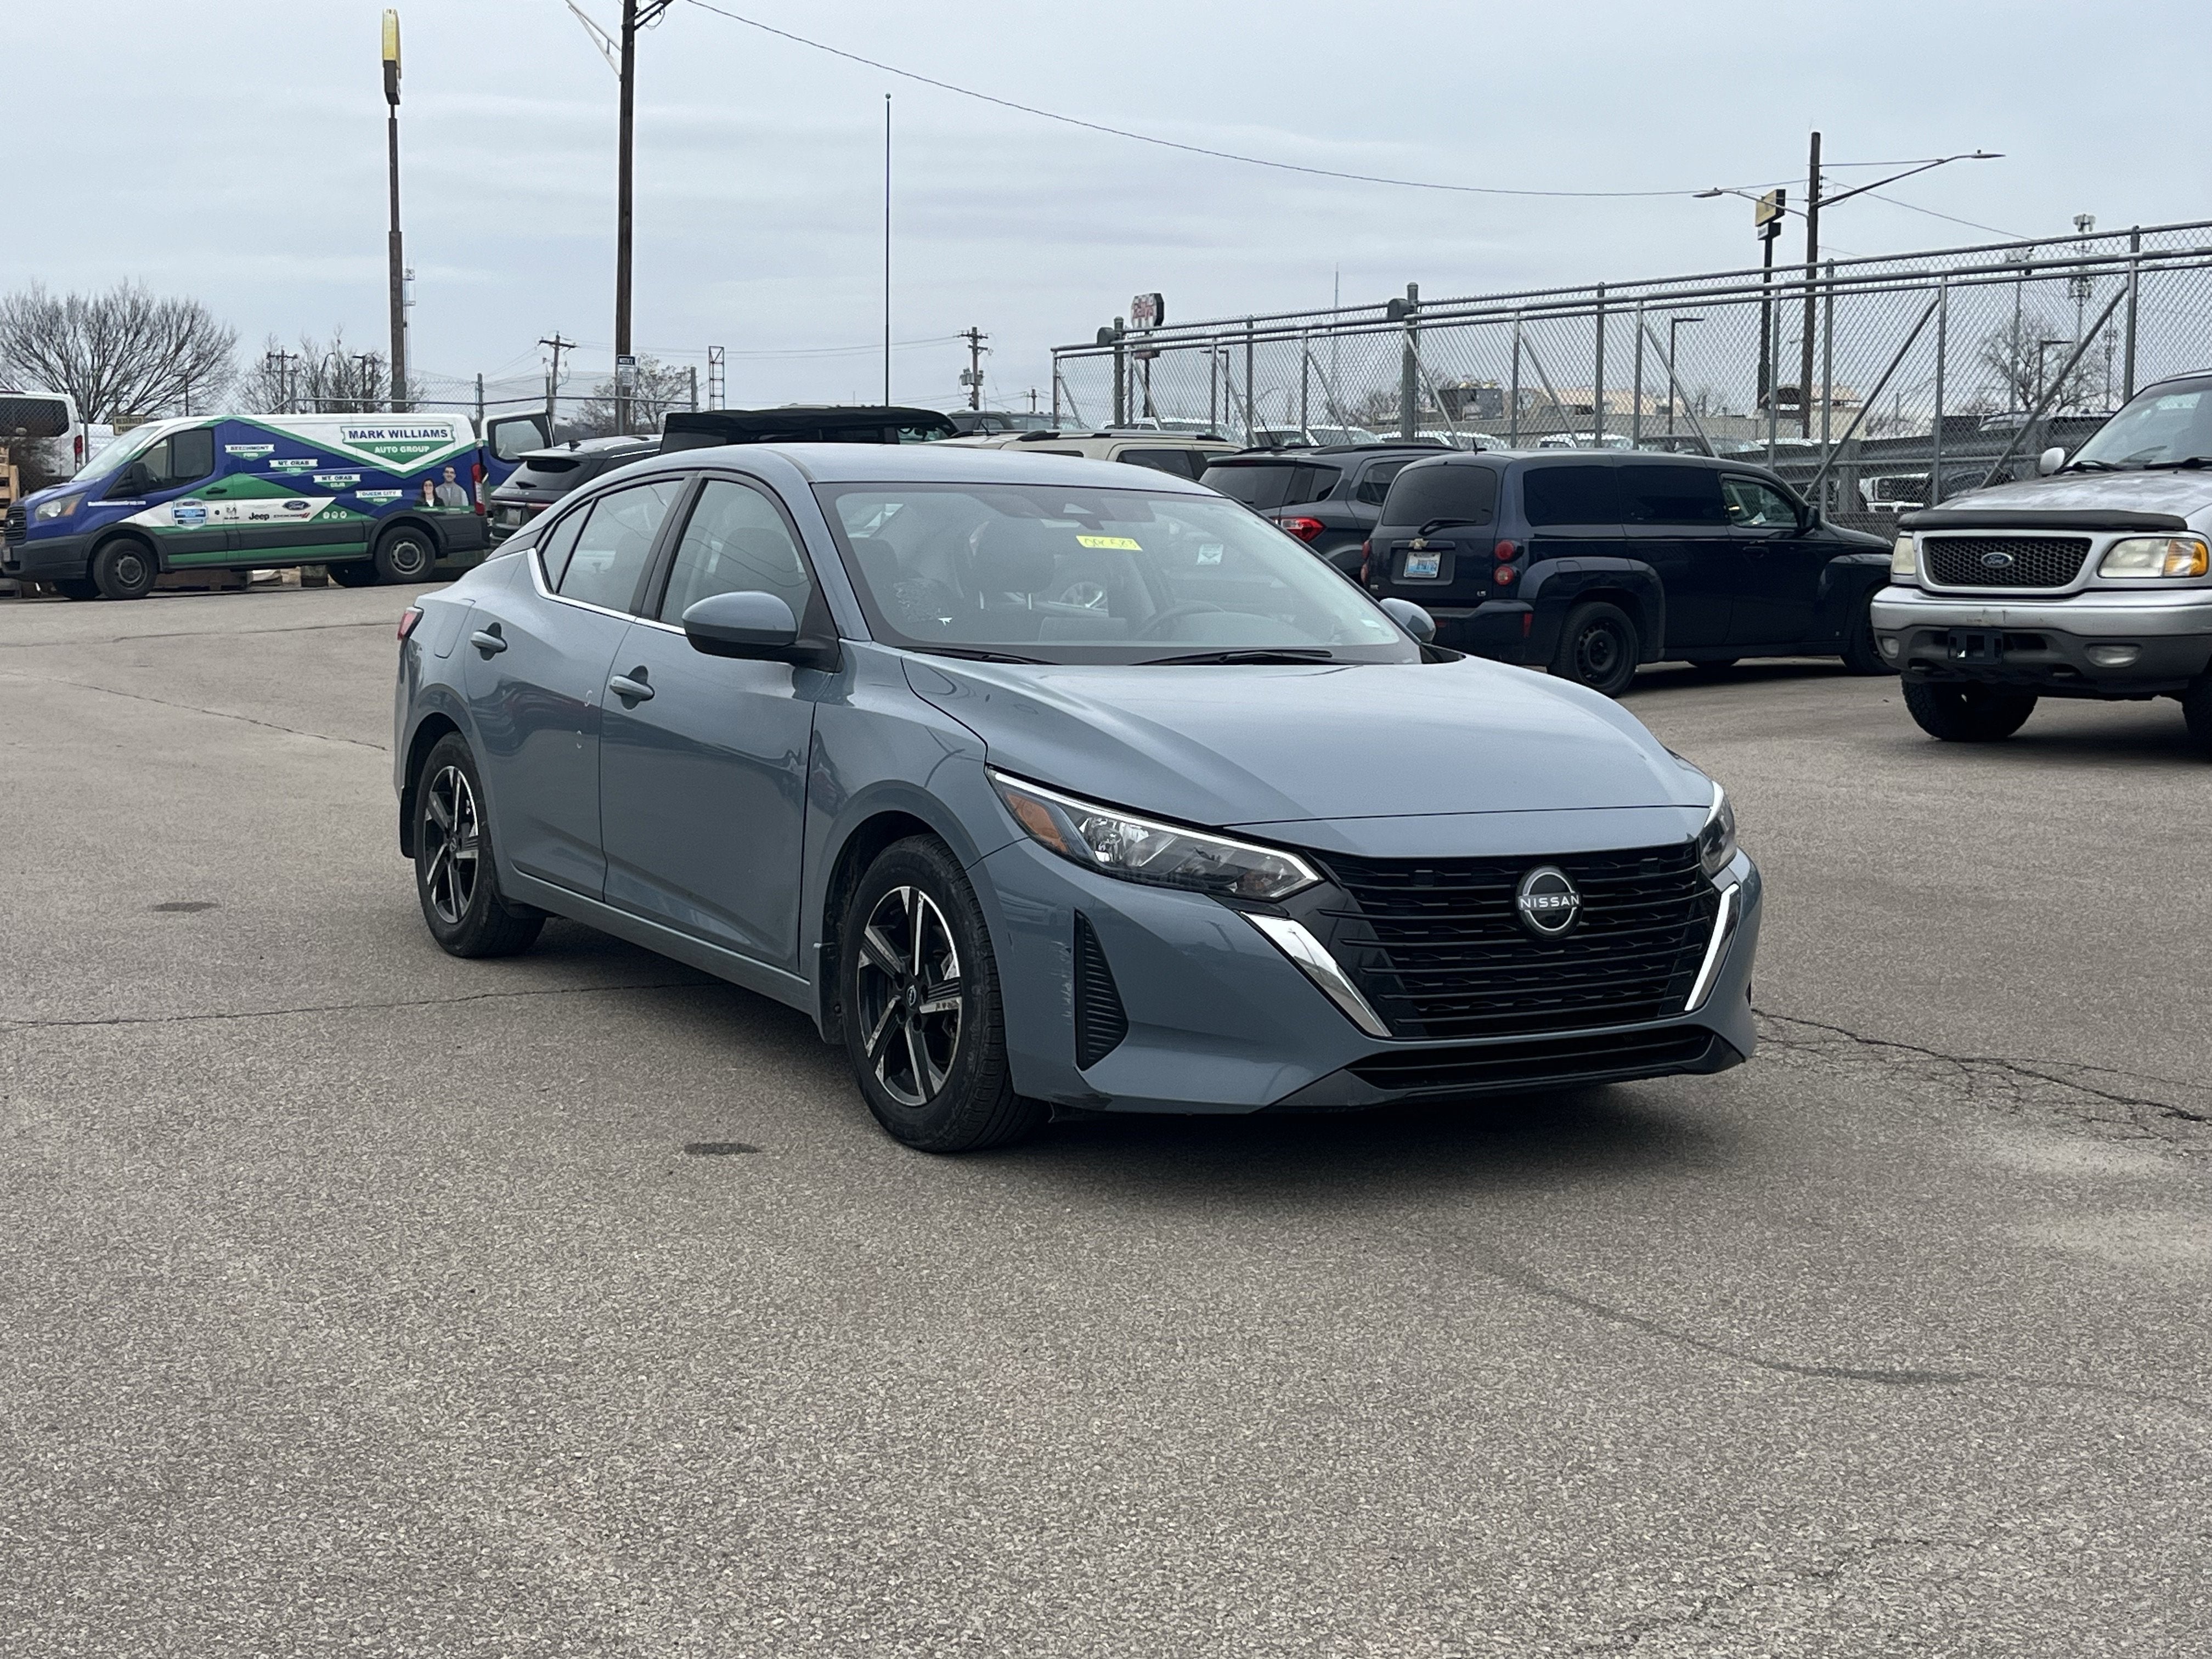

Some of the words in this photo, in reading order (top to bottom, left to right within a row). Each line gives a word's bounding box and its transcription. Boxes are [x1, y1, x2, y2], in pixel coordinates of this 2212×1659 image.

[348, 430, 385, 439] MARK
[388, 430, 448, 438] WILLIAMS
[249, 512, 270, 521] Jeep
[1520, 894, 1580, 909] NISSAN
